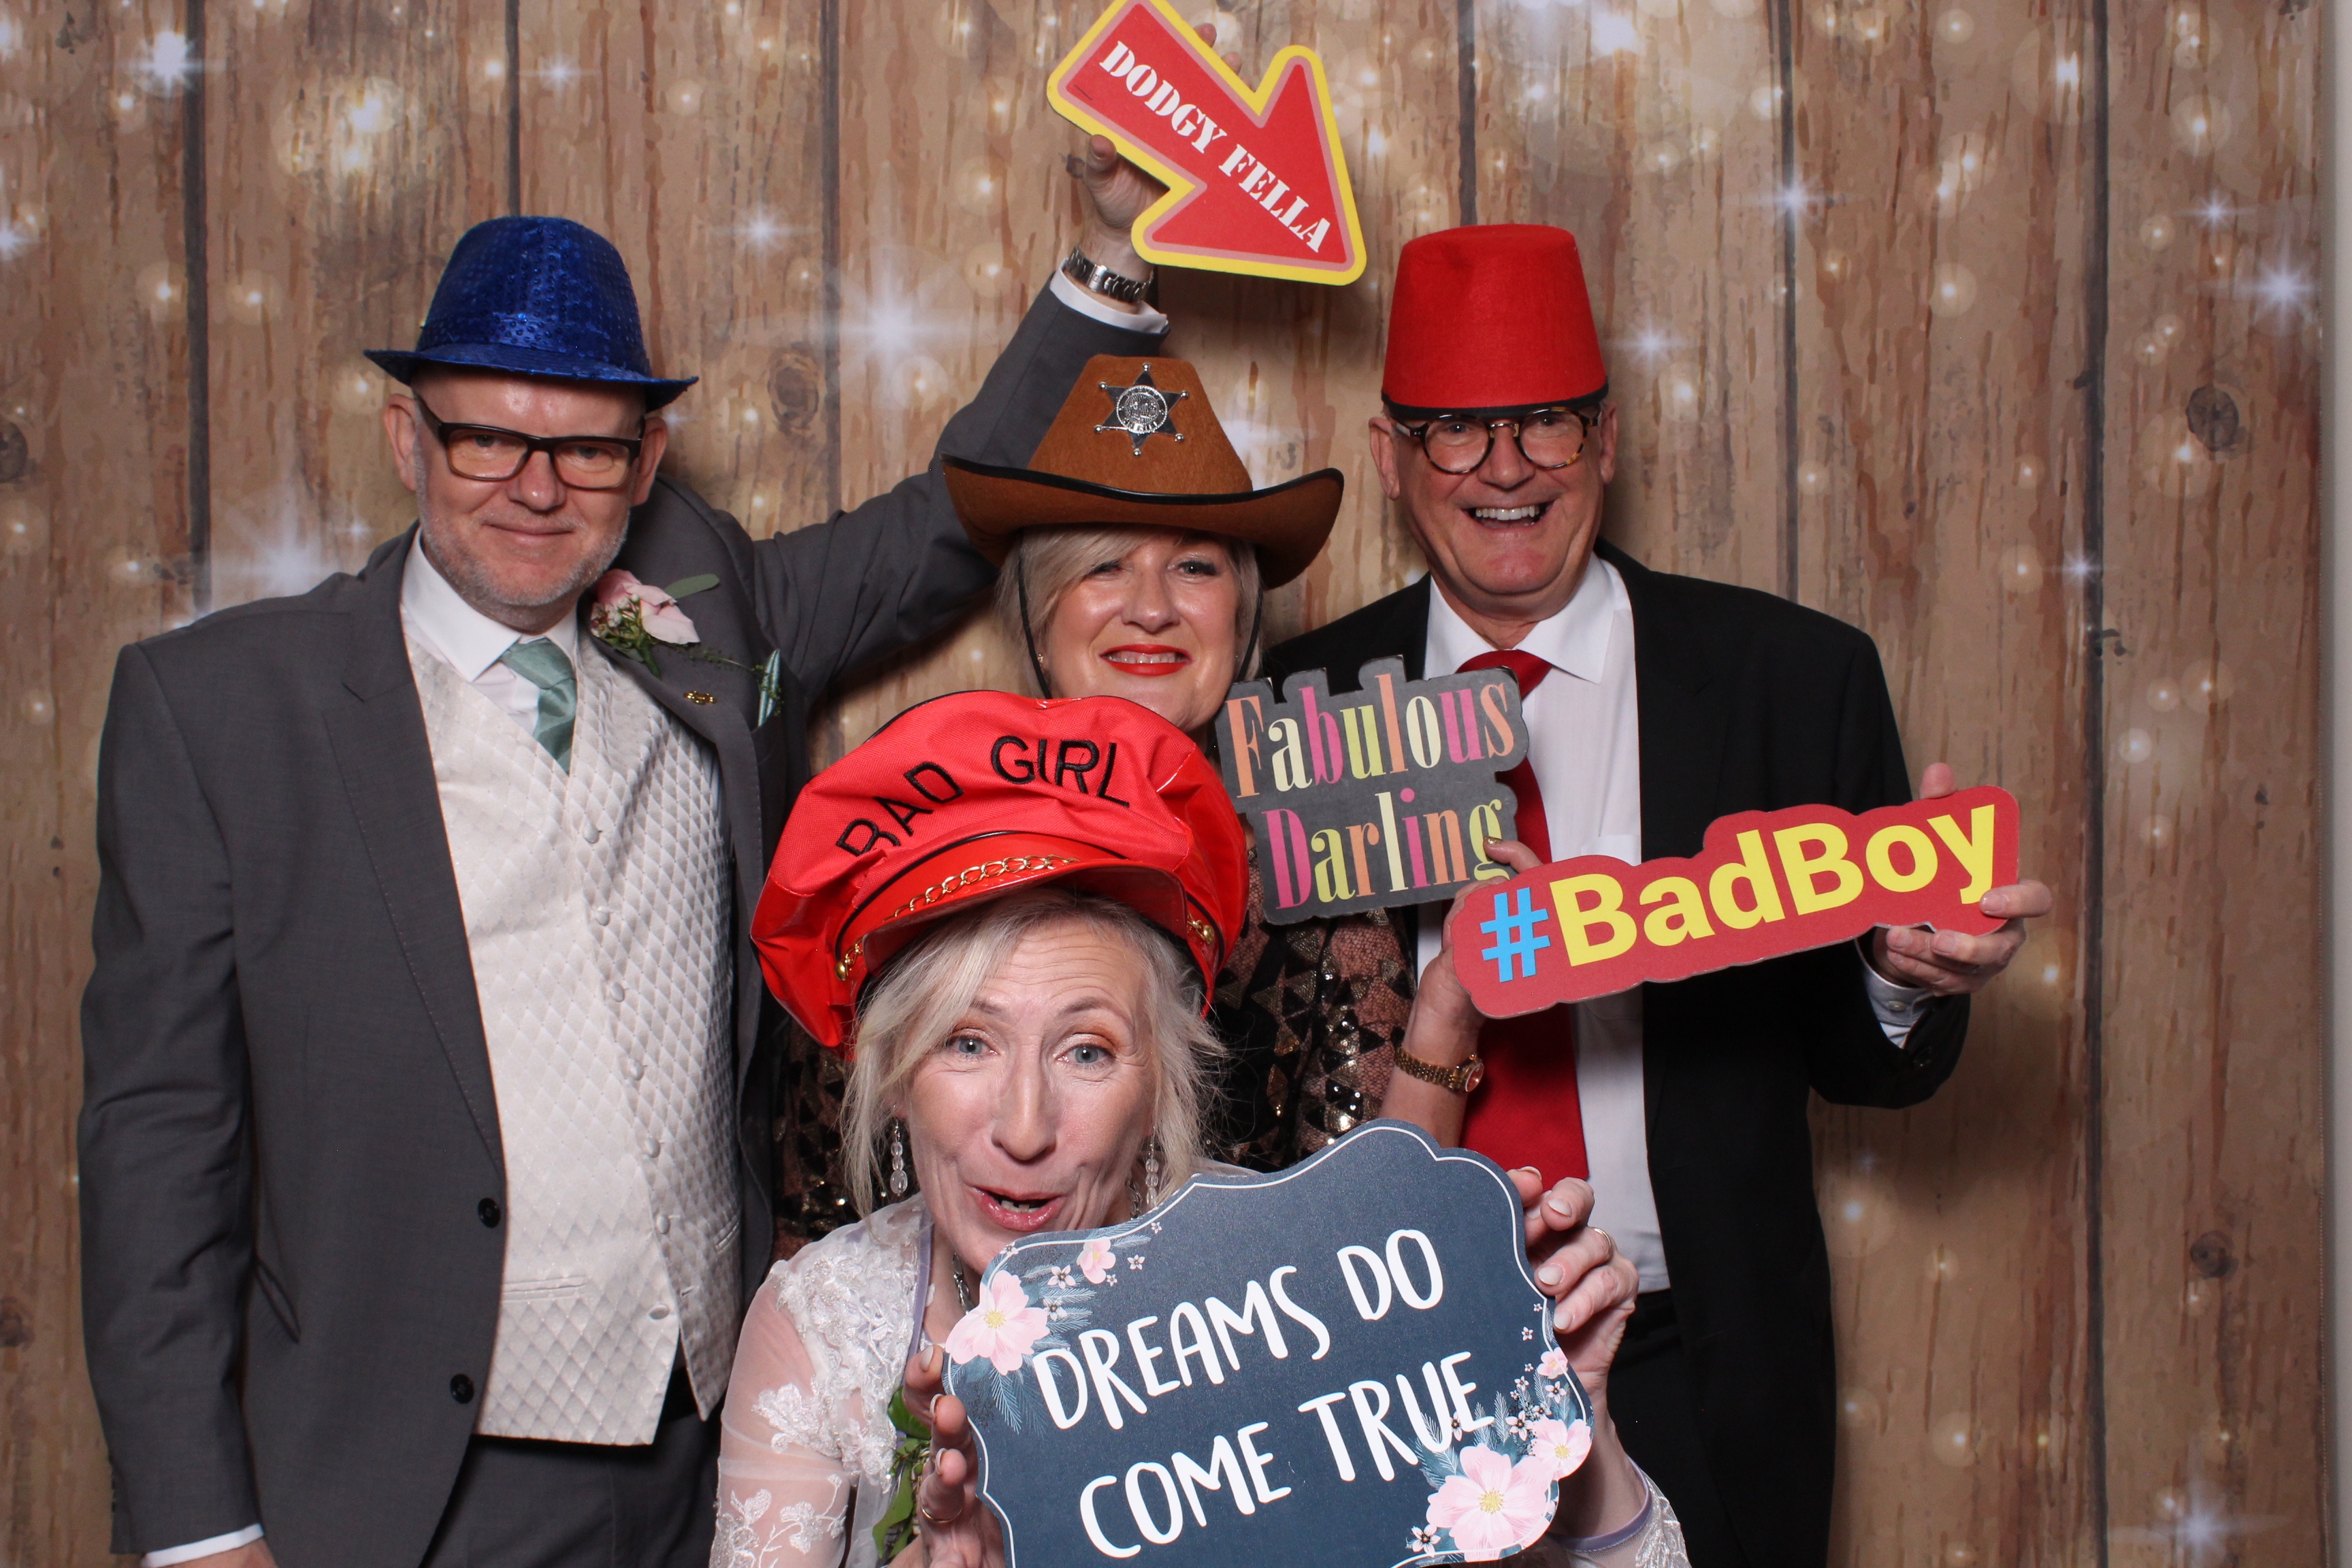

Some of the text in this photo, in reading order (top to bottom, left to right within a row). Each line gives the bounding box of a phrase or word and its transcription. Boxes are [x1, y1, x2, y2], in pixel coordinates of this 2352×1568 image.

[1098, 41, 1331, 253] DODGY FELLA
[836, 736, 1130, 856] BAD GIRL
[1225, 673, 1515, 798] Fabulous
[1260, 791, 1510, 910] Darling
[1480, 804, 1995, 983] #BadBoy
[1032, 1229, 1443, 1431] DREAMS DO
[1079, 1351, 1494, 1558] COME TRUE
